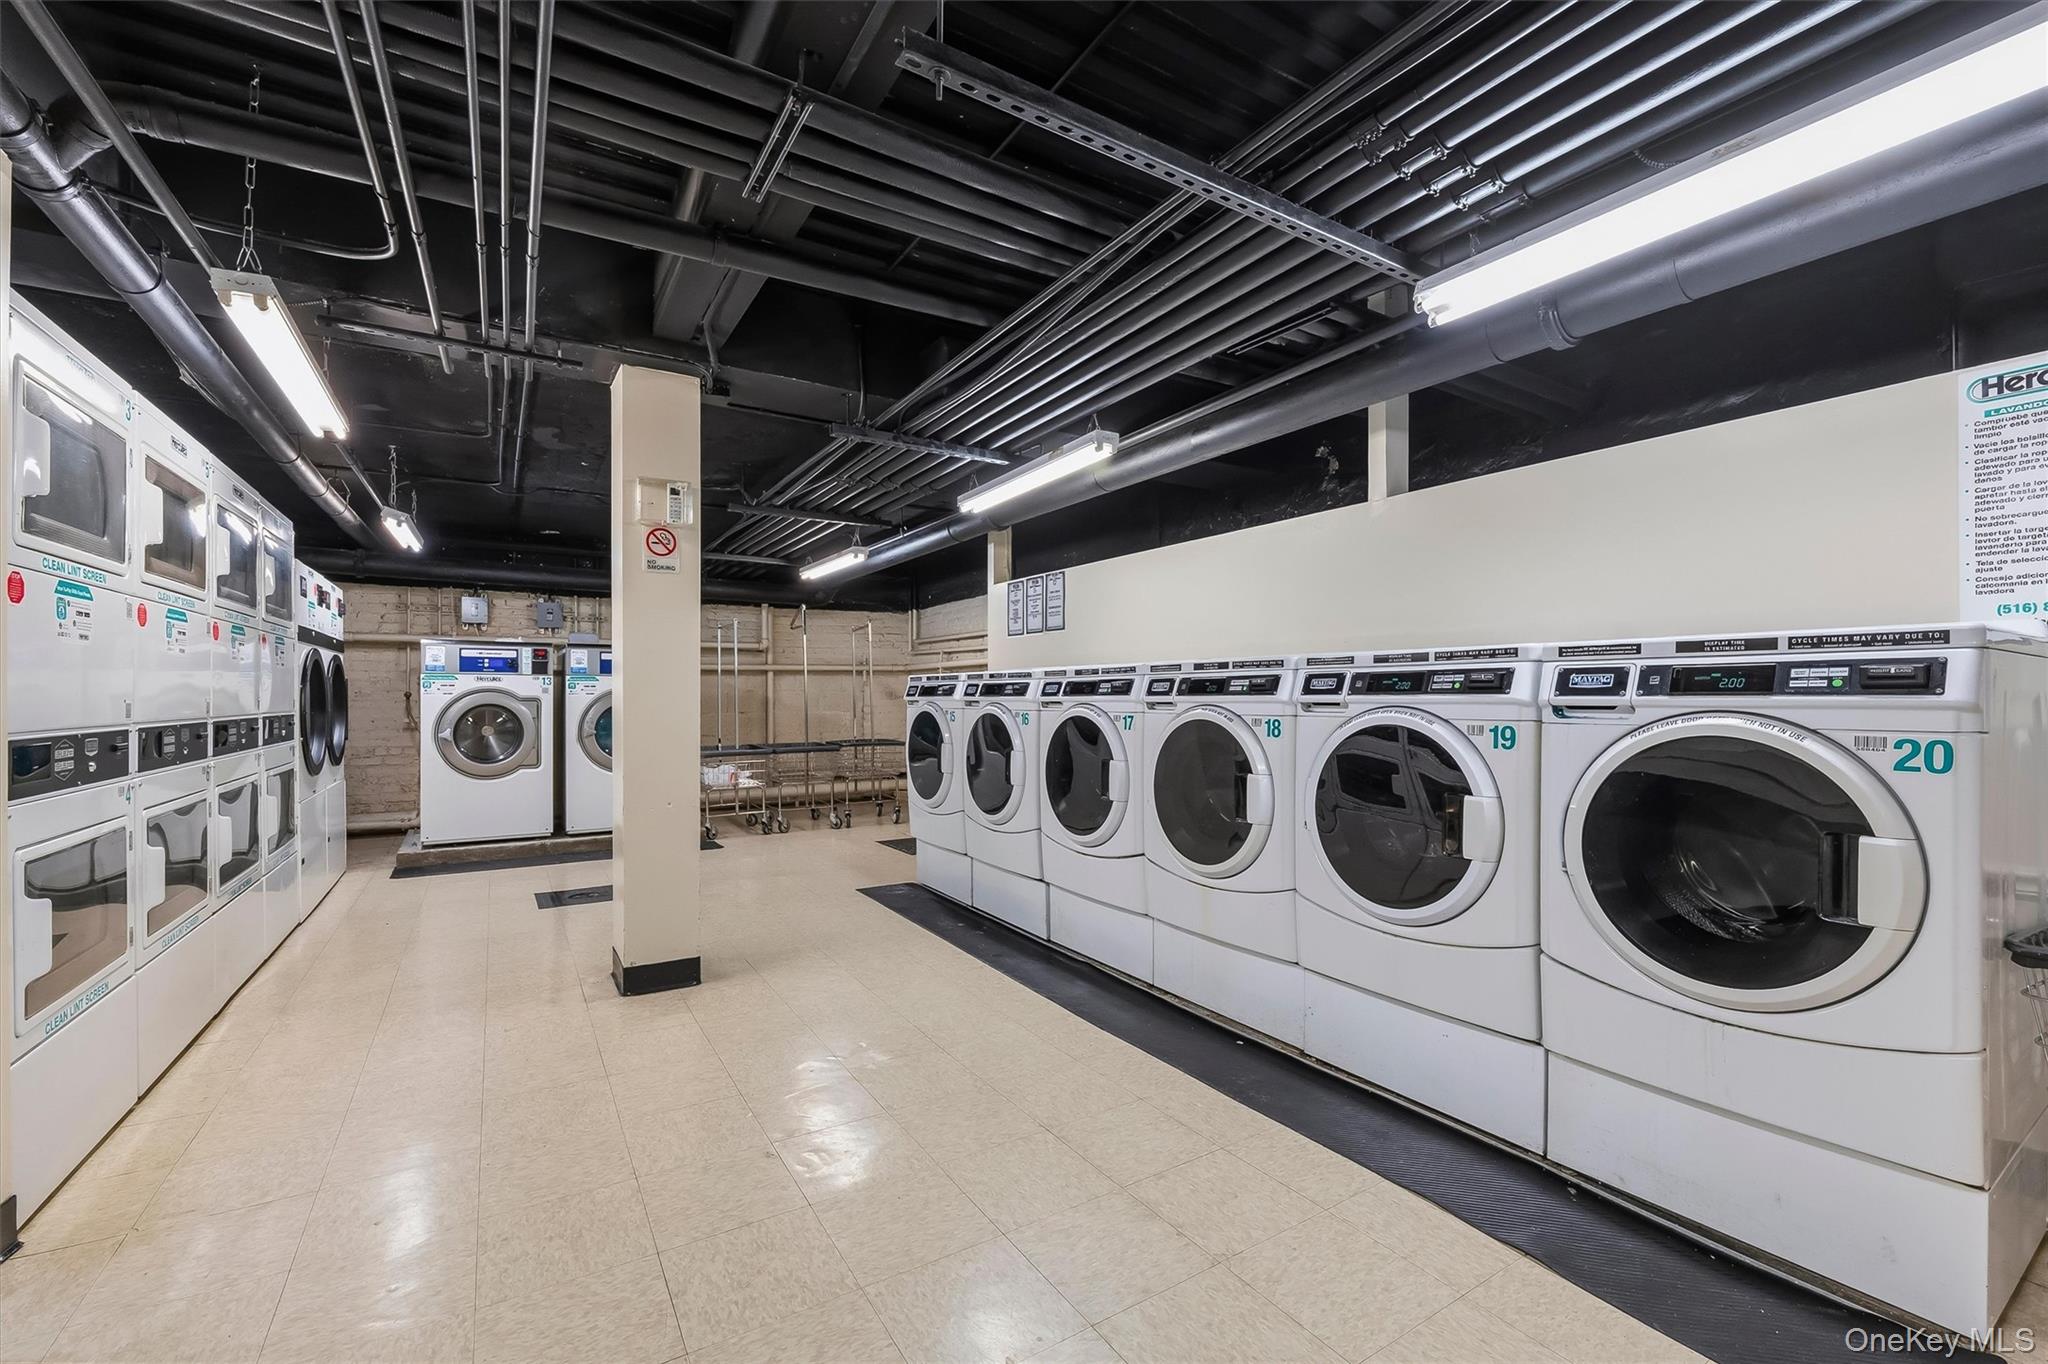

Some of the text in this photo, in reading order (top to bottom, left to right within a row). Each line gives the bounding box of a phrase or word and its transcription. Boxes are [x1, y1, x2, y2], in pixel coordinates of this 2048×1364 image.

[1974, 431, 2002, 440] limpio
[1974, 454, 2018, 465] Clasificar
[2019, 458, 2040, 466] para
[1974, 469, 2004, 478] lavado
[2015, 465, 2036, 473] para
[1974, 505, 2005, 514] puerta
[1975, 530, 2011, 538] Insertar
[42, 557, 107, 584] CLEAN LINT SCREEN
[1975, 566, 2003, 574] ajuste
[1975, 588, 2015, 596] lavadora
[1997, 601, 2038, 616] (516)
[1791, 637, 1818, 645] CYCLE
[1876, 633, 1901, 641] VARY
[1905, 632, 1923, 640] DUE
[541, 677, 552, 686] 13
[1572, 675, 1611, 686] MAYTAG
[1020, 713, 1030, 726] 16
[1123, 715, 1134, 730] 17
[1265, 718, 1281, 737] 18
[1630, 725, 1655, 740] PLEASE
[1656, 719, 1680, 730] LEAVE
[1758, 721, 1777, 731] NOT
[1777, 726, 1788, 735] IN
[1788, 730, 1808, 744] USE
[1488, 724, 1516, 750] 19
[1893, 738, 1954, 774] 20
[161, 934, 176, 949] CLEAN
[44, 981, 110, 1035] CLEAN LINT SCREEN
